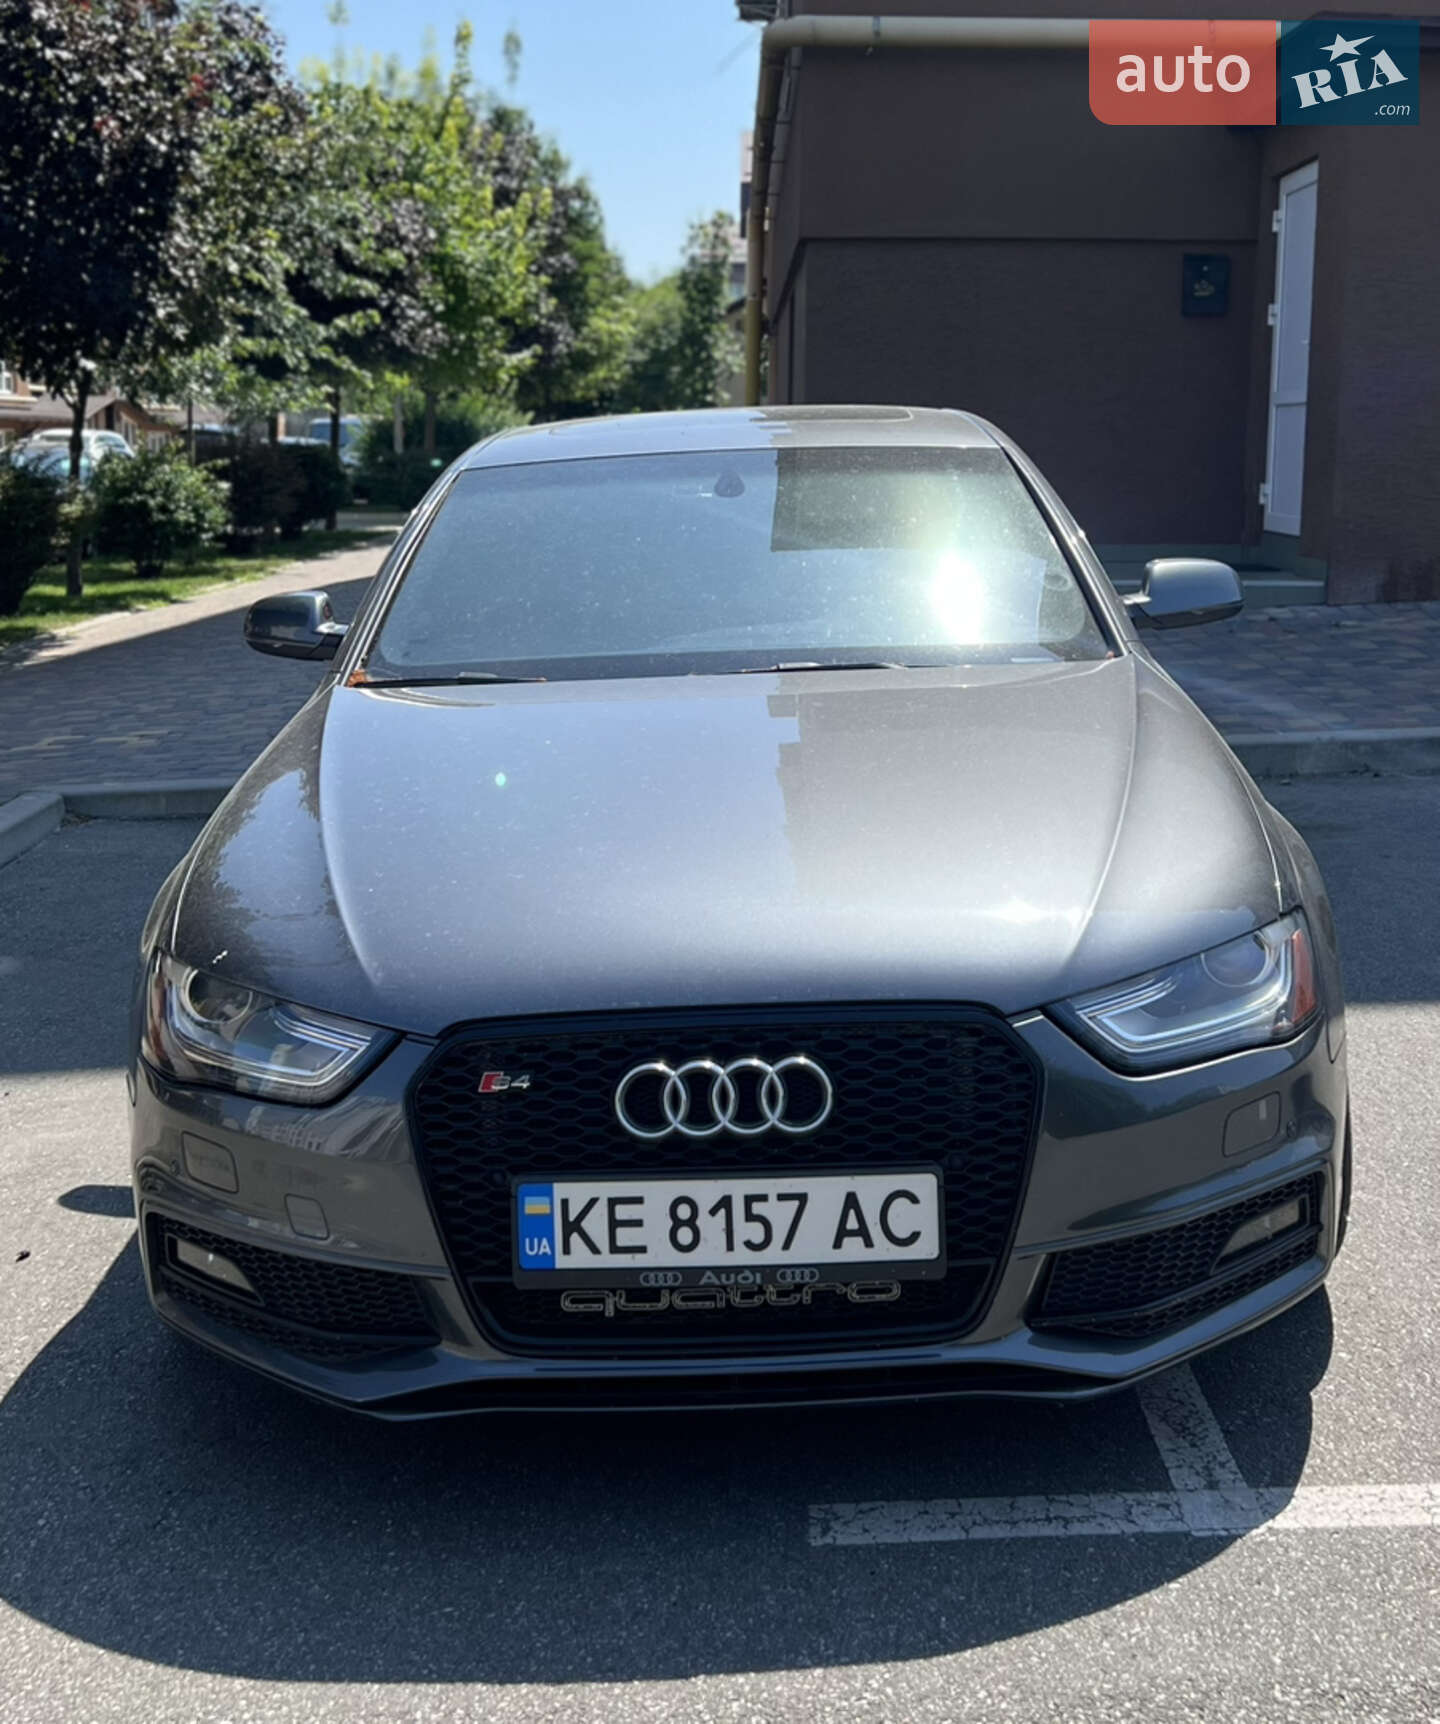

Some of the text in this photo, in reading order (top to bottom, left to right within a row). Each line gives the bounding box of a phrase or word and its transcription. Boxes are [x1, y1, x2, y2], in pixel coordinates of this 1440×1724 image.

[560, 1189, 921, 1256] KE 8157 AC
[525, 1237, 551, 1256] UA
[700, 1269, 761, 1285] Audi
